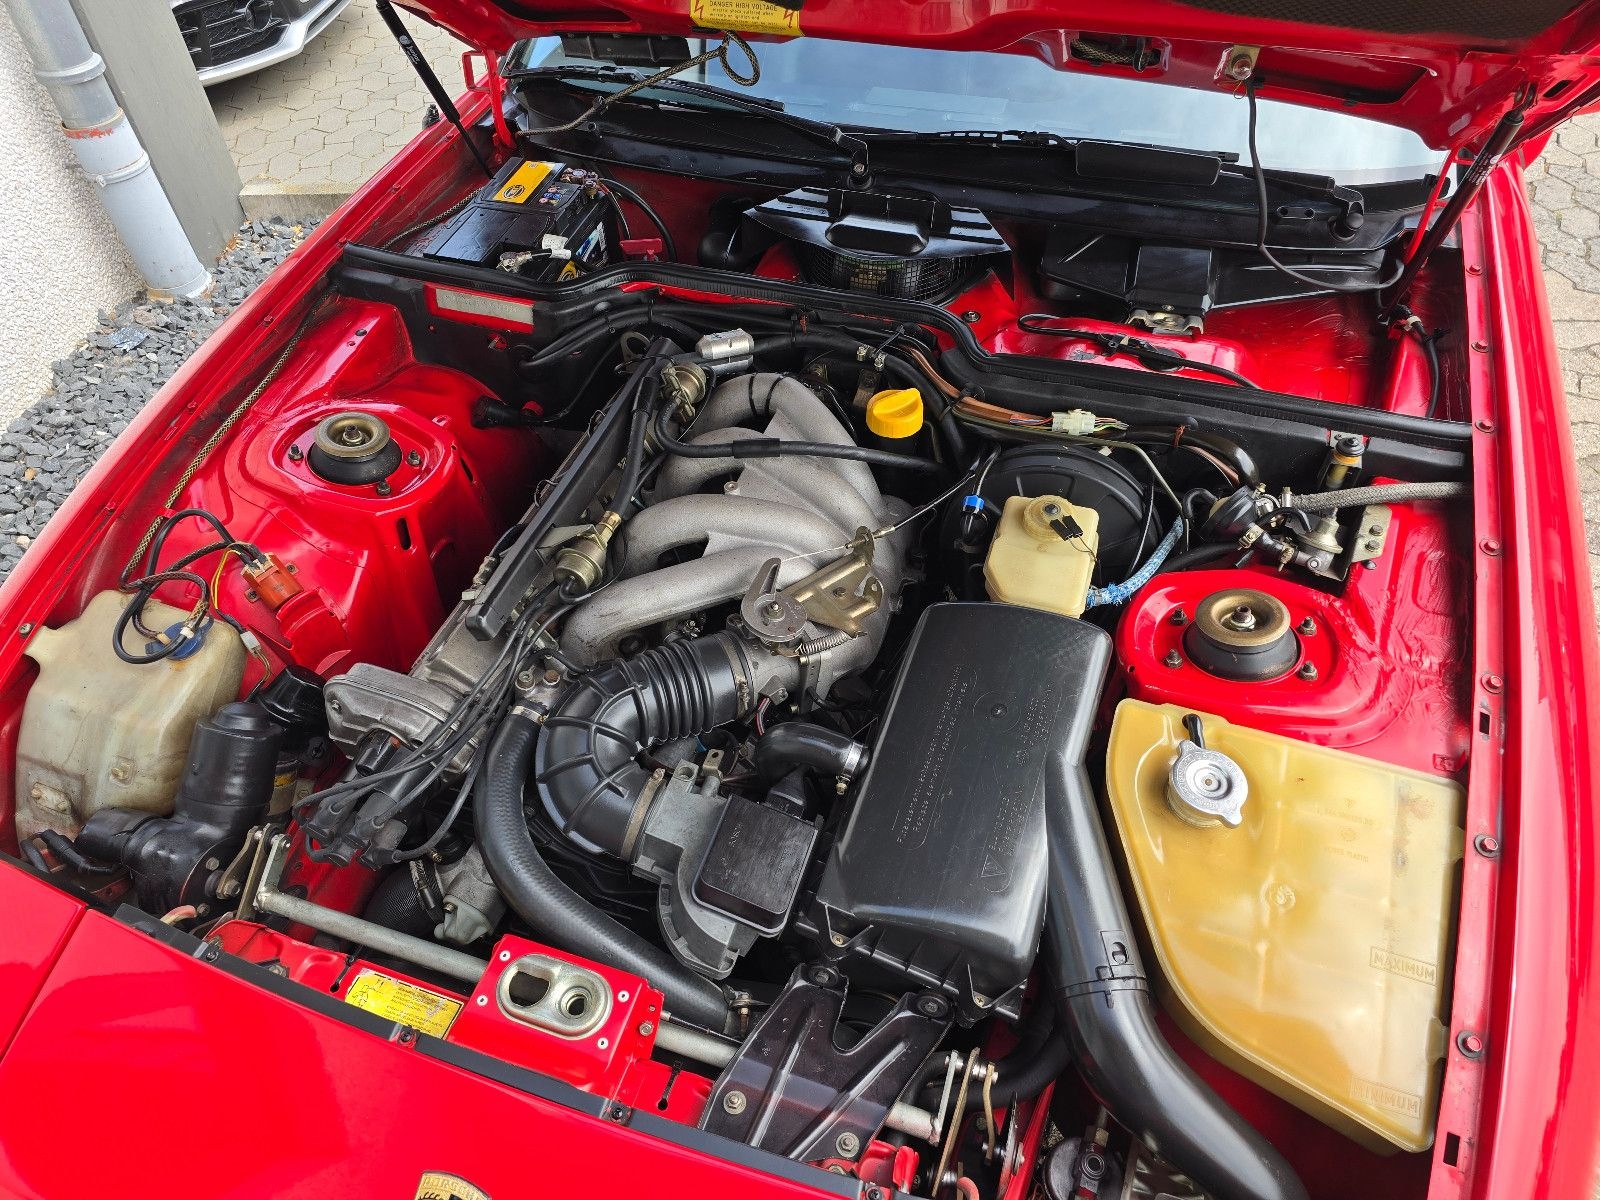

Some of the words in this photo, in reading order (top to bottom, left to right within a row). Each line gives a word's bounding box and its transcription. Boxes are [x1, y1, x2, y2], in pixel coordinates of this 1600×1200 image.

[752, 2, 778, 12] VOLTAGE
[1374, 952, 1436, 981] MAXIMUM
[1354, 1081, 1420, 1114] MINIMUM
